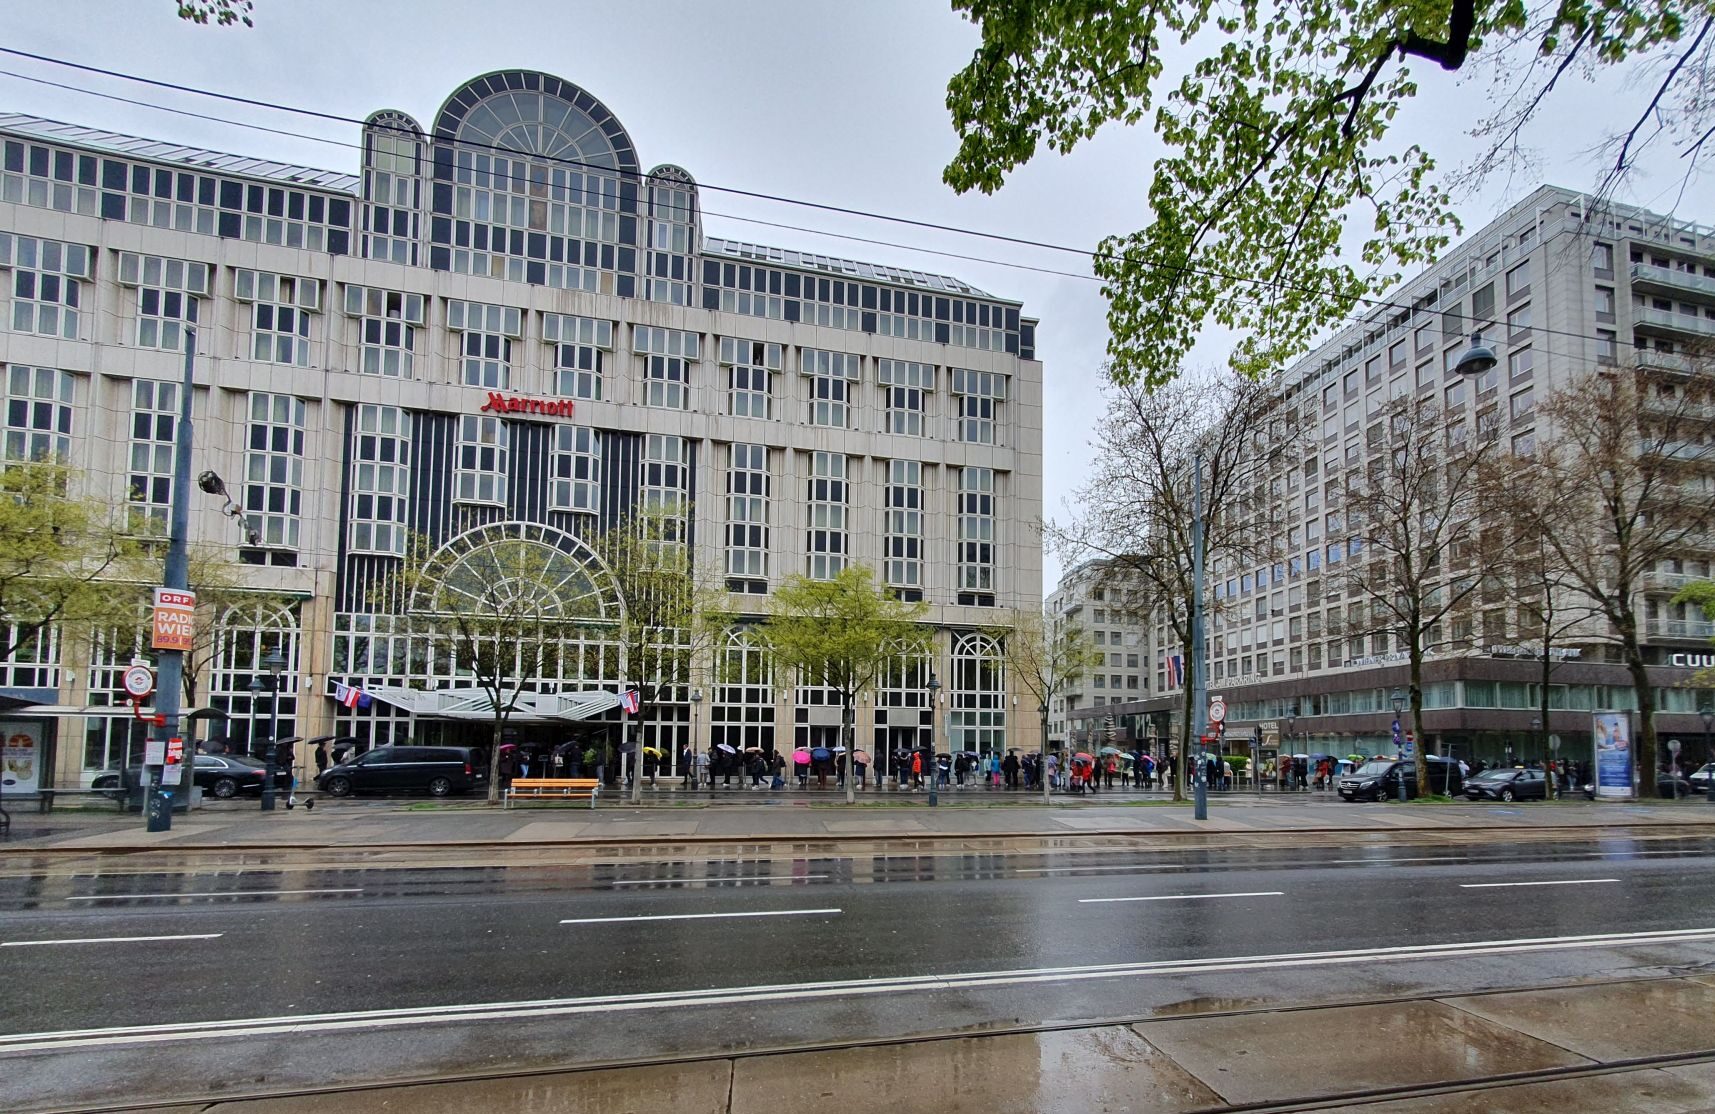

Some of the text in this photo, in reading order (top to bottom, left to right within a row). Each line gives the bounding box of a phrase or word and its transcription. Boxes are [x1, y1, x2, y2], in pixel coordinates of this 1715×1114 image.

[481, 392, 573, 417] Marriott
[162, 594, 190, 604] ORF
[1259, 722, 1279, 730] HOTEL
